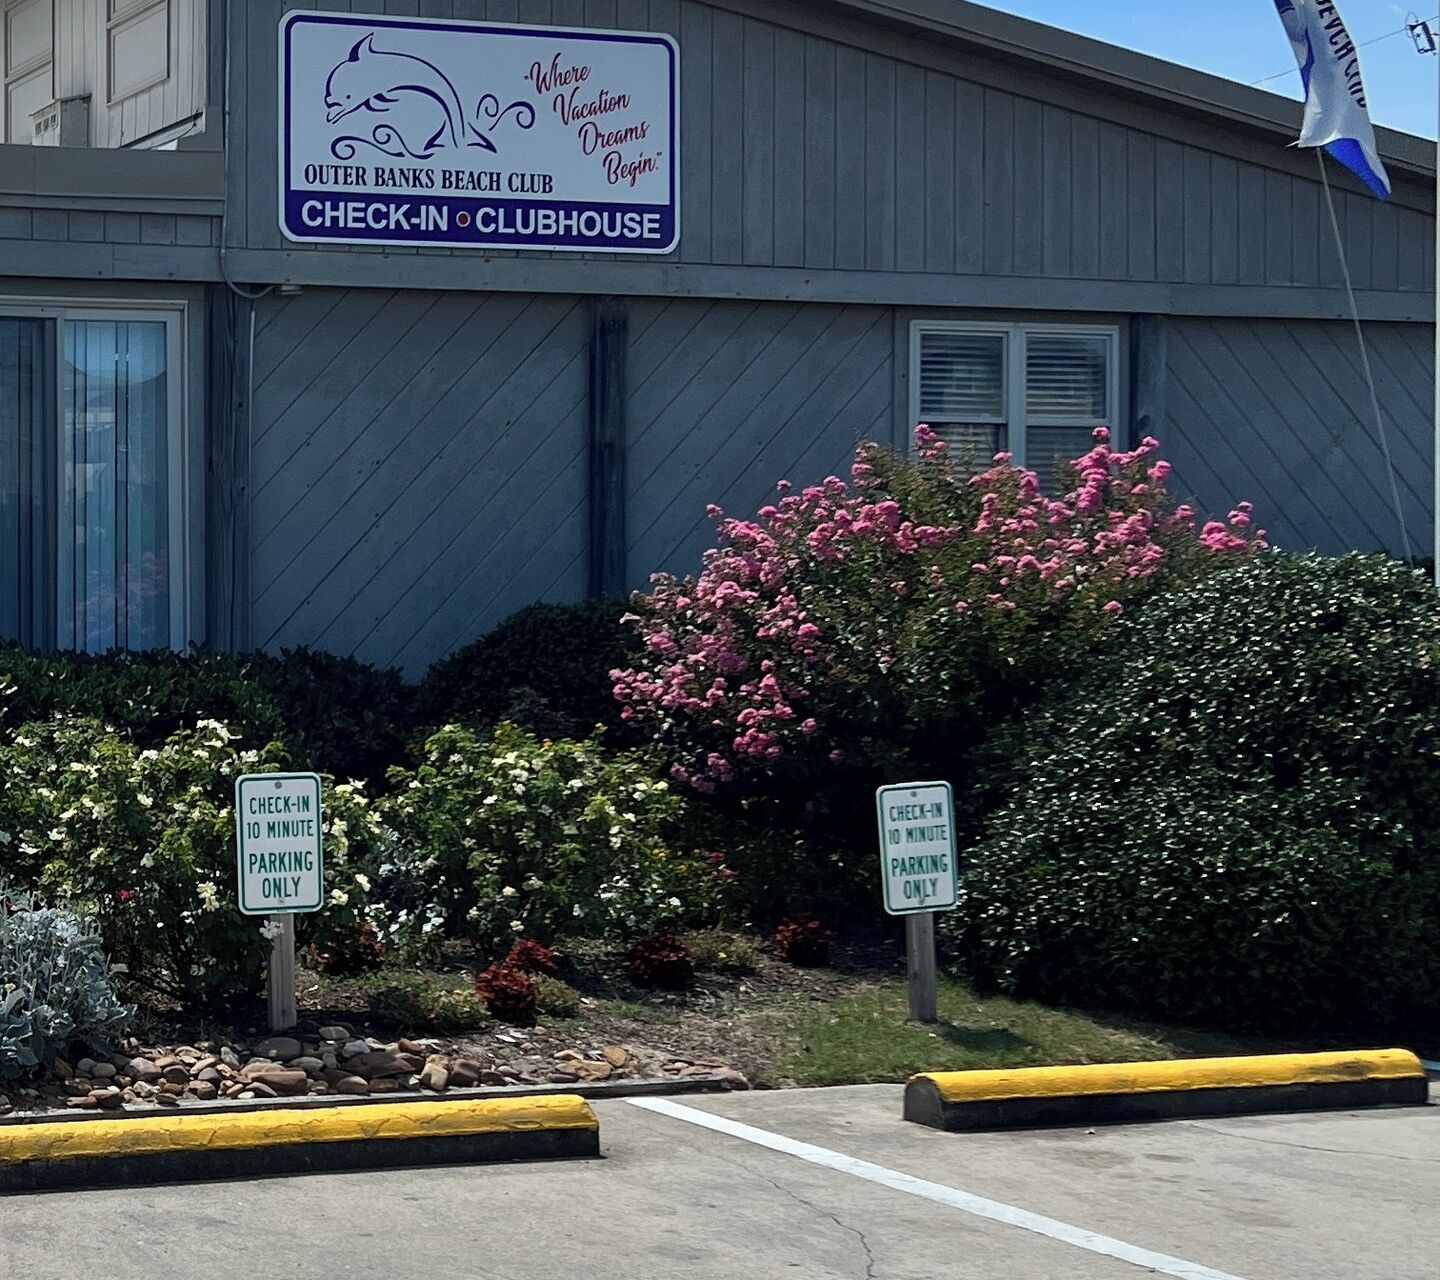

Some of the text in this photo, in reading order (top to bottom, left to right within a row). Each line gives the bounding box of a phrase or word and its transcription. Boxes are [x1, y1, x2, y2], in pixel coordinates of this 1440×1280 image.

[553, 87, 631, 125] Vacation
[578, 121, 650, 155] Dreams
[304, 163, 553, 194] OUTER BANKS BEACH CLUB
[301, 200, 661, 239] CHECK-IN CLUBHOUSE
[249, 795, 310, 815] CHECK-IN
[889, 802, 943, 822] CHECK-IN
[246, 820, 314, 839] 10 MINUTE
[888, 825, 947, 845] 10 MINUTE
[249, 851, 313, 874] PARKING
[891, 854, 948, 877] PARKING
[262, 876, 301, 899] ONLY
[903, 878, 938, 899] ONLY
